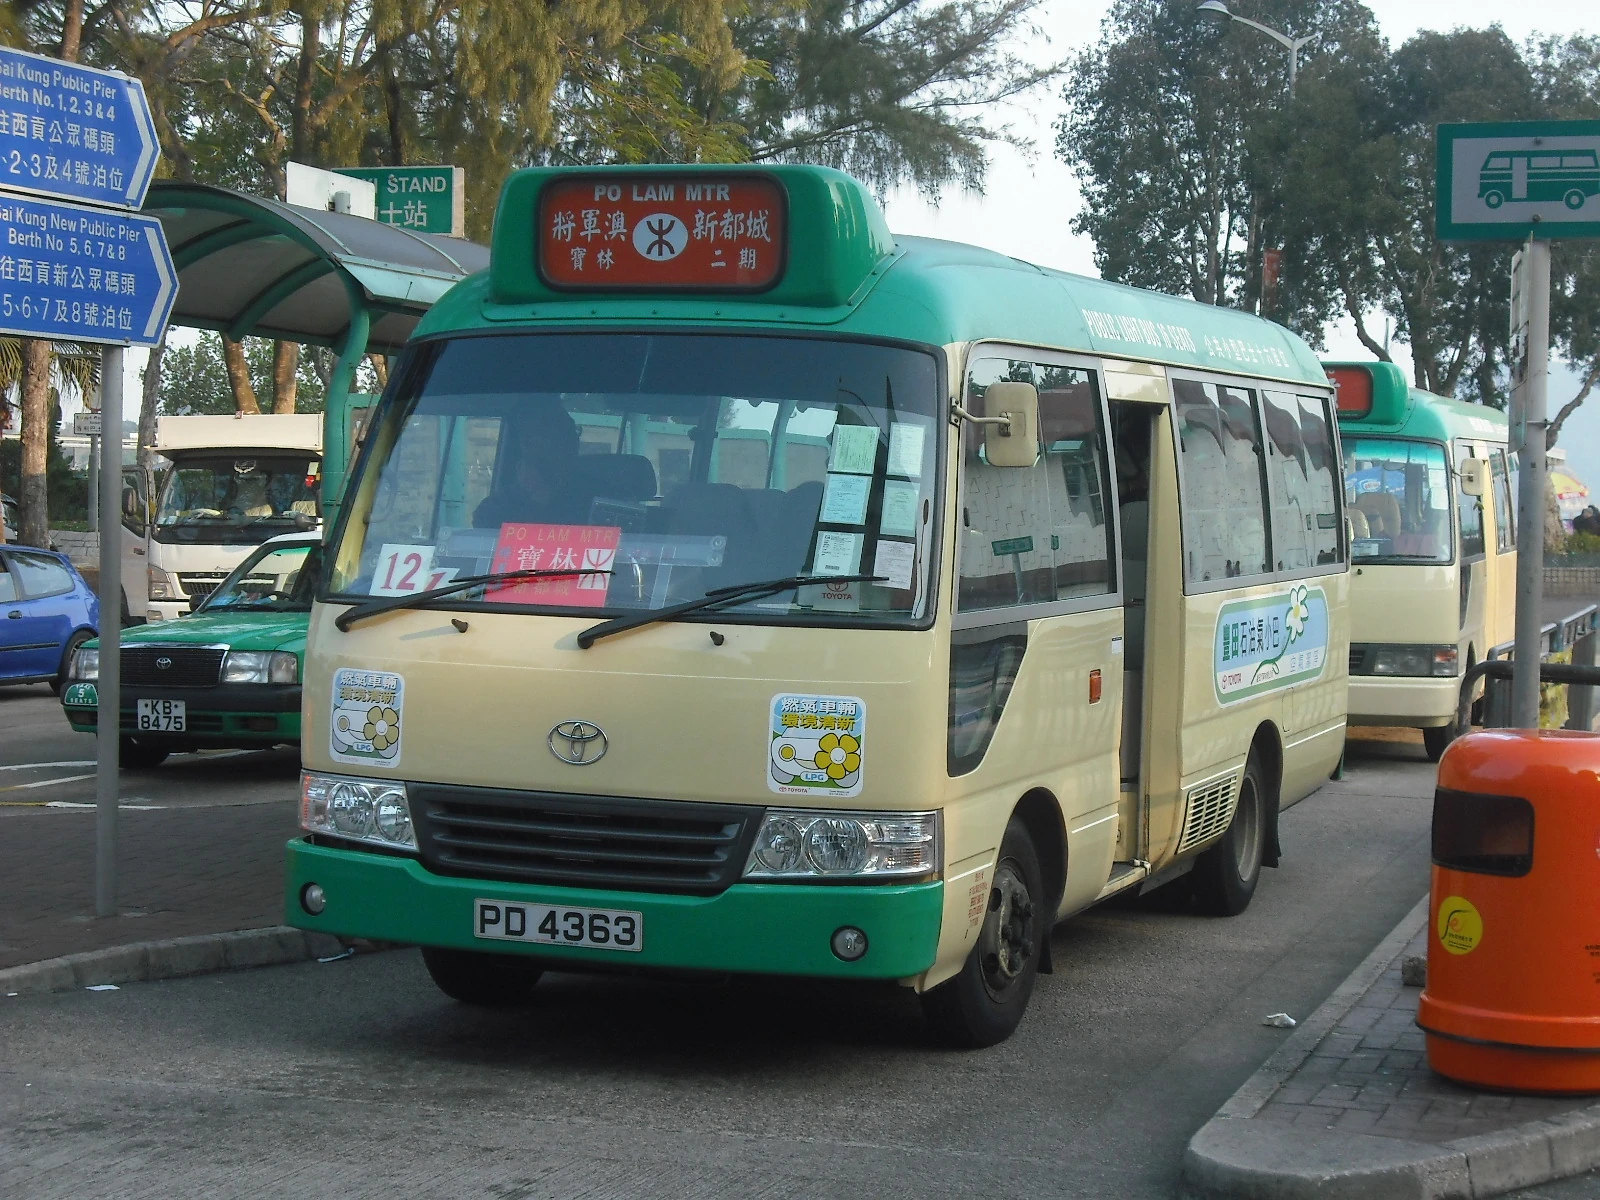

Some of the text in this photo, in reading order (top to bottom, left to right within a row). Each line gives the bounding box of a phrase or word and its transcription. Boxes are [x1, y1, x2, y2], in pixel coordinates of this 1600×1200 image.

[17, 62, 50, 88] Kung
[53, 70, 90, 95] Public
[93, 79, 117, 100] Pier
[0, 84, 29, 103] erth
[33, 88, 54, 108] No.
[84, 100, 93, 116] 3
[95, 102, 104, 119] &
[106, 105, 115, 122] 4
[387, 174, 447, 194] STAND
[594, 184, 731, 202] PO LAM MTR
[16, 206, 47, 231] Kung
[50, 212, 77, 232] New
[80, 217, 116, 239] Public
[118, 224, 141, 243] Pier
[375, 199, 427, 227] 士站
[552, 208, 772, 244] 將軍澳 新都城
[8, 227, 42, 249] Berth
[46, 233, 64, 252] No
[97, 241, 105, 258] 7
[107, 243, 115, 259] &
[118, 245, 125, 261] 8
[570, 246, 757, 271] 寶林 二期
[0, 255, 136, 297] 往西貢新公眾碼頭
[1081, 308, 1122, 341] PUBLIC
[1117, 315, 1145, 344] LIGHT
[1138, 318, 1162, 348] BUS
[1167, 325, 1197, 355] SEATS
[506, 527, 614, 543] PO LAM MTR
[517, 545, 578, 570] 寶林
[380, 552, 422, 591] 12
[822, 592, 852, 600] TOYOTA
[78, 688, 85, 698] 5
[151, 700, 172, 716] KB
[782, 697, 857, 716] 燃氣車輛
[140, 714, 184, 731] 8475
[781, 713, 856, 732] 環境清新
[356, 743, 371, 752] LPG
[805, 773, 824, 781] LPG
[479, 904, 636, 947] PD 4363
